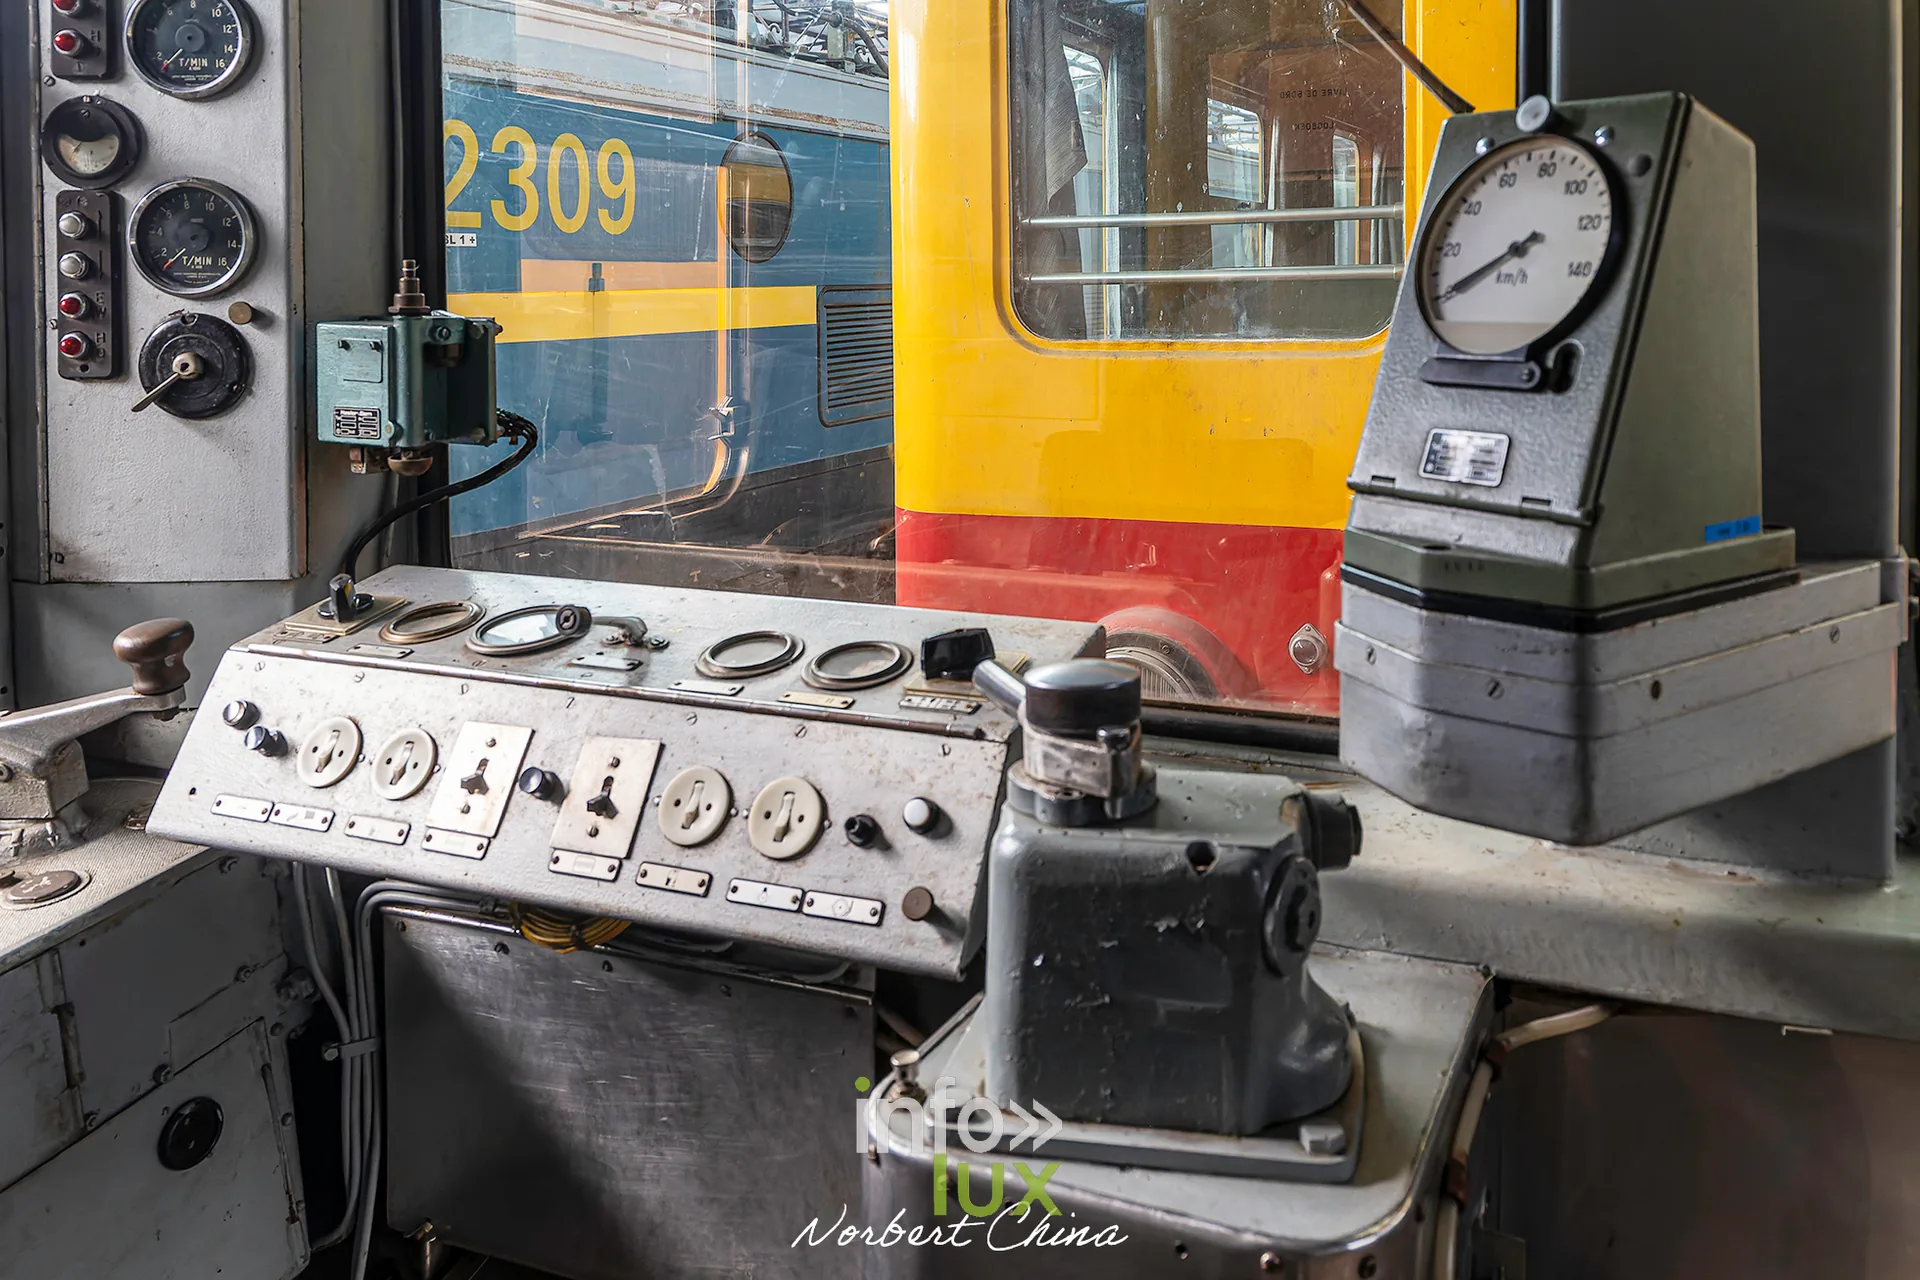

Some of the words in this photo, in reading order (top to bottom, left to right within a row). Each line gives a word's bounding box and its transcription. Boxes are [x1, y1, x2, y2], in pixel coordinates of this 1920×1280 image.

[211, 9, 221, 18] 10
[223, 25, 232, 33] 12
[224, 44, 233, 53] 14
[179, 58, 208, 68] T/MIN
[215, 59, 225, 69] 16
[1537, 162, 1557, 178] 80
[443, 119, 636, 235] 2309
[1498, 172, 1517, 188] 60
[1563, 179, 1588, 196] 100
[184, 200, 190, 210] 8
[205, 202, 215, 212] 10
[1464, 200, 1482, 216] 40
[222, 218, 231, 227] 12
[1577, 214, 1602, 231] 120
[156, 227, 163, 236] 4
[227, 240, 237, 249] 14
[161, 247, 167, 257] 2
[1443, 242, 1462, 258] 20
[182, 256, 212, 266] T/MIN
[218, 257, 227, 267] 16
[1567, 261, 1593, 278] 140
[1495, 267, 1529, 287] km/h
